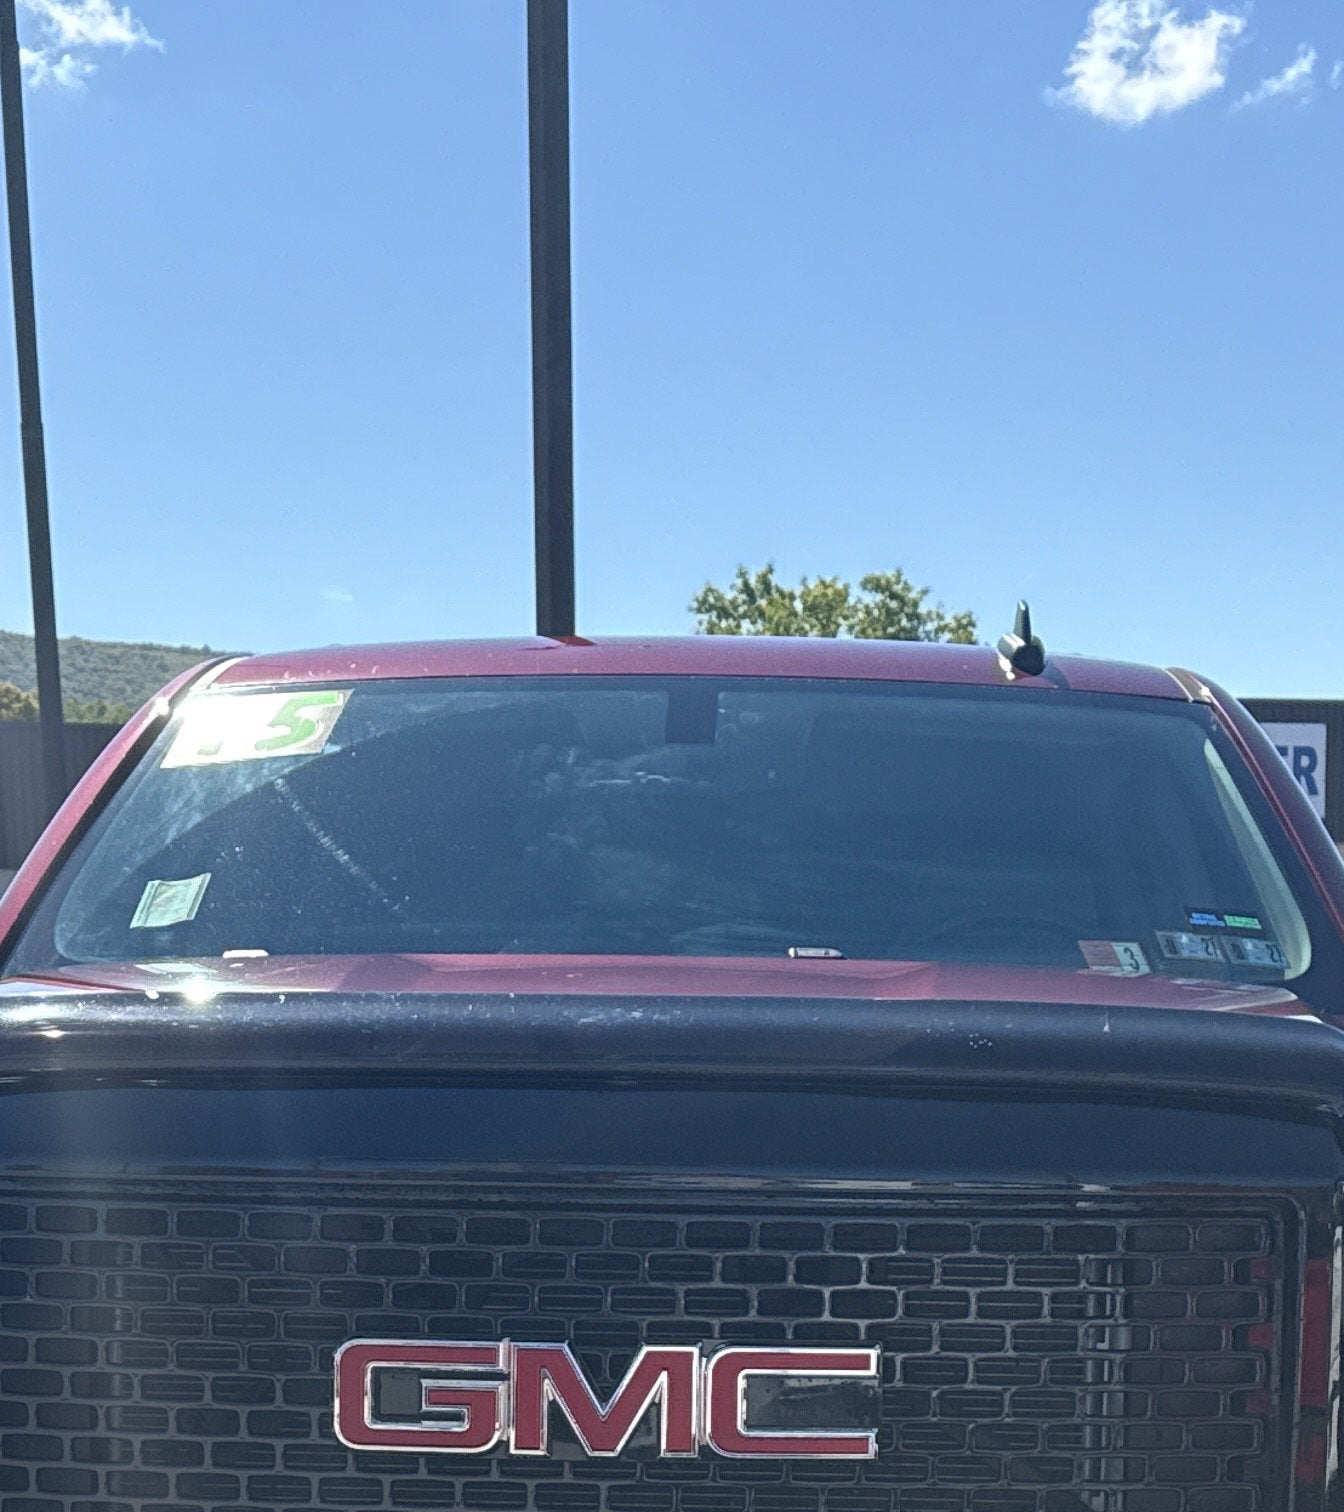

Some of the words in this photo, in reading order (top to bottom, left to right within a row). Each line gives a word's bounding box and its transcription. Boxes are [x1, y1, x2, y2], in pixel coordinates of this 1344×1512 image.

[1275, 745, 1319, 795] R
[1122, 946, 1140, 971] 3
[333, 1337, 881, 1460] GMC
